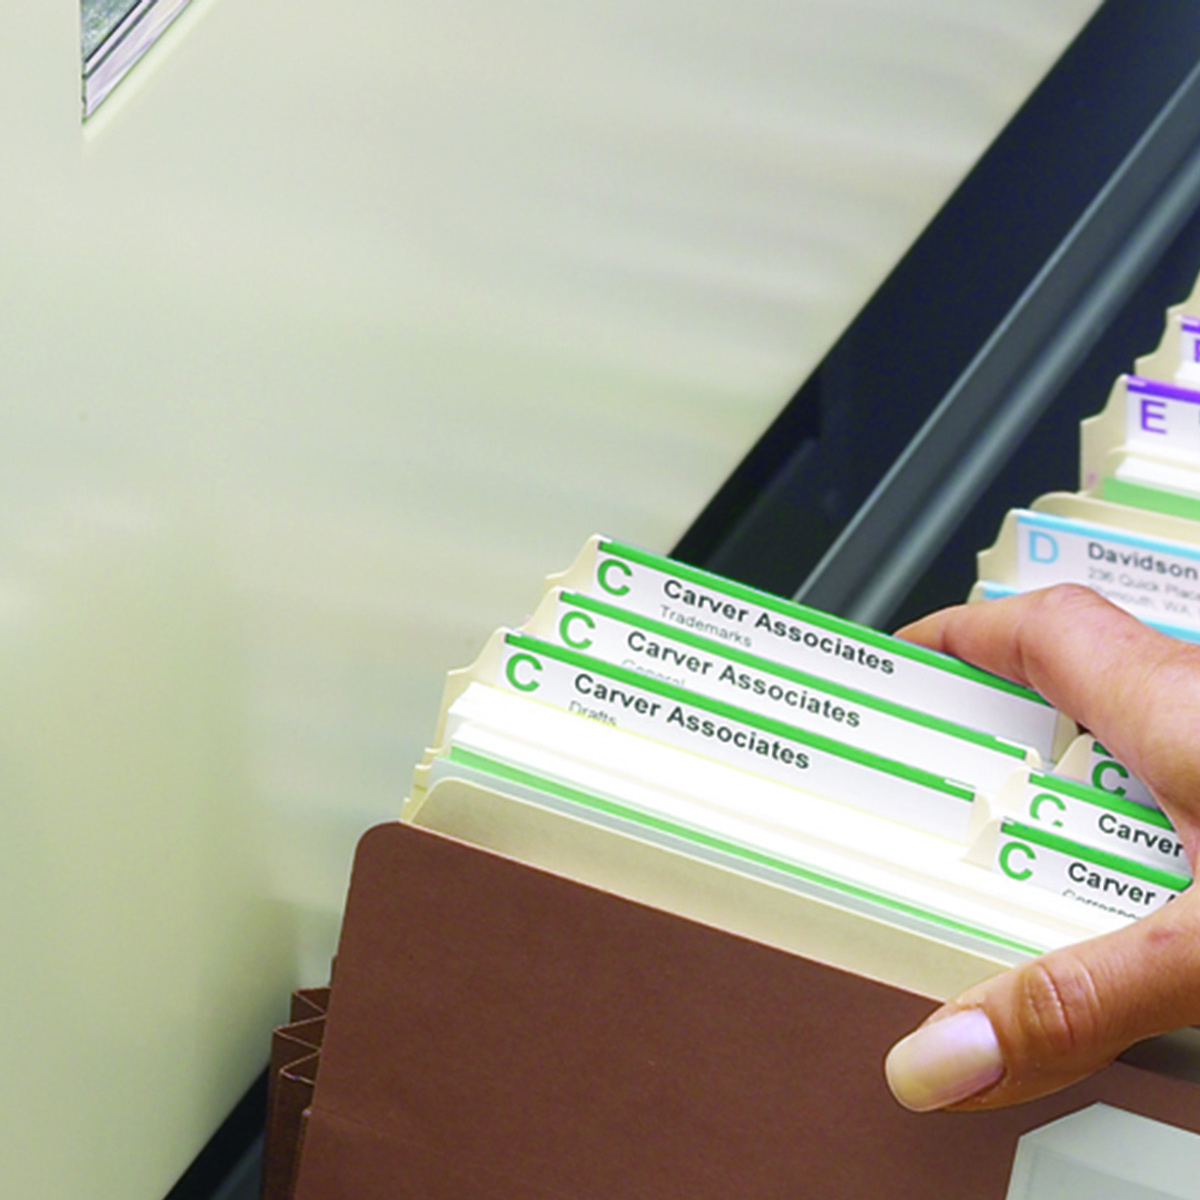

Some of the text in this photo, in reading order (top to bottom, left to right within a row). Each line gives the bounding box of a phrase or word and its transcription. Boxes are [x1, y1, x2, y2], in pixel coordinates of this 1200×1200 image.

[1028, 531, 1059, 564] D
[1088, 542, 1198, 580] Davidson
[660, 604, 752, 647] Trademarks
[664, 580, 895, 675] Carver Associates
[627, 631, 860, 728] Carver Associates
[575, 673, 810, 769] Carver Associates
[1098, 814, 1183, 857] Carver
[1068, 862, 1155, 906] Carver
